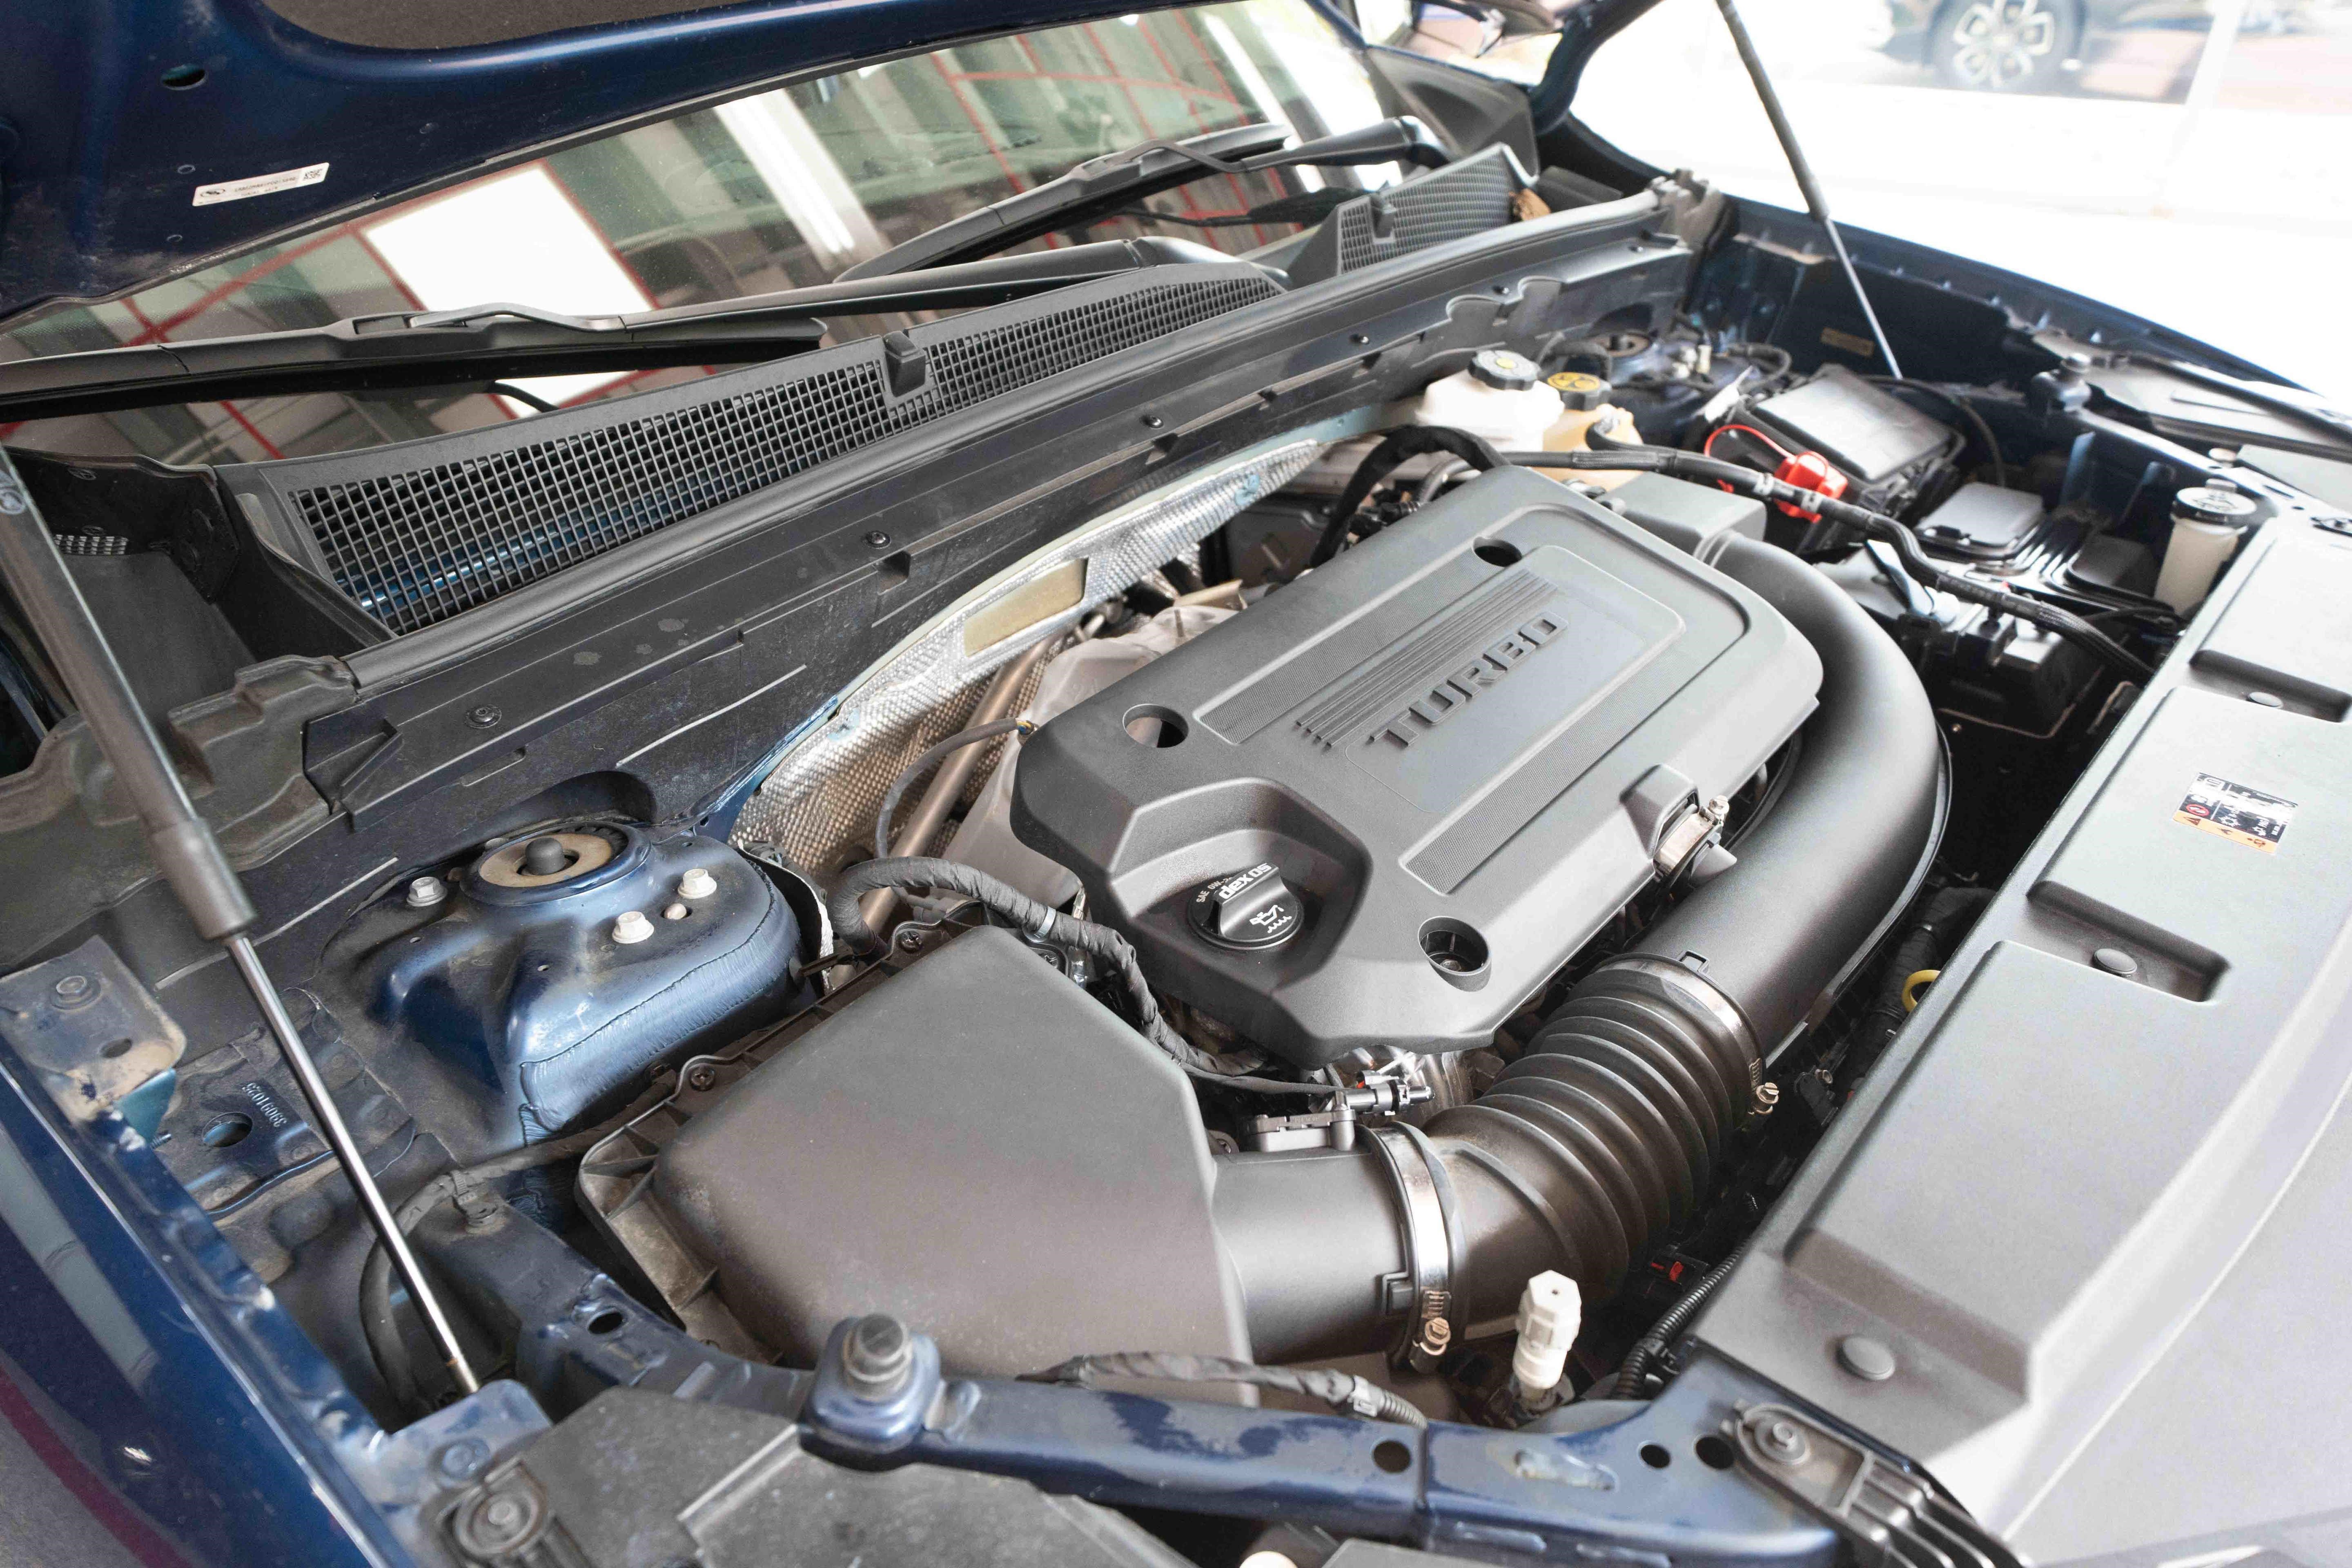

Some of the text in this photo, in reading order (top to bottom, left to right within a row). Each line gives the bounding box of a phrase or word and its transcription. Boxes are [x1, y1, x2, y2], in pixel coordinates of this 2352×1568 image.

[1366, 611, 1569, 748] TURBO
[1196, 891, 1209, 902] SAE
[1219, 863, 1272, 899] dexos
